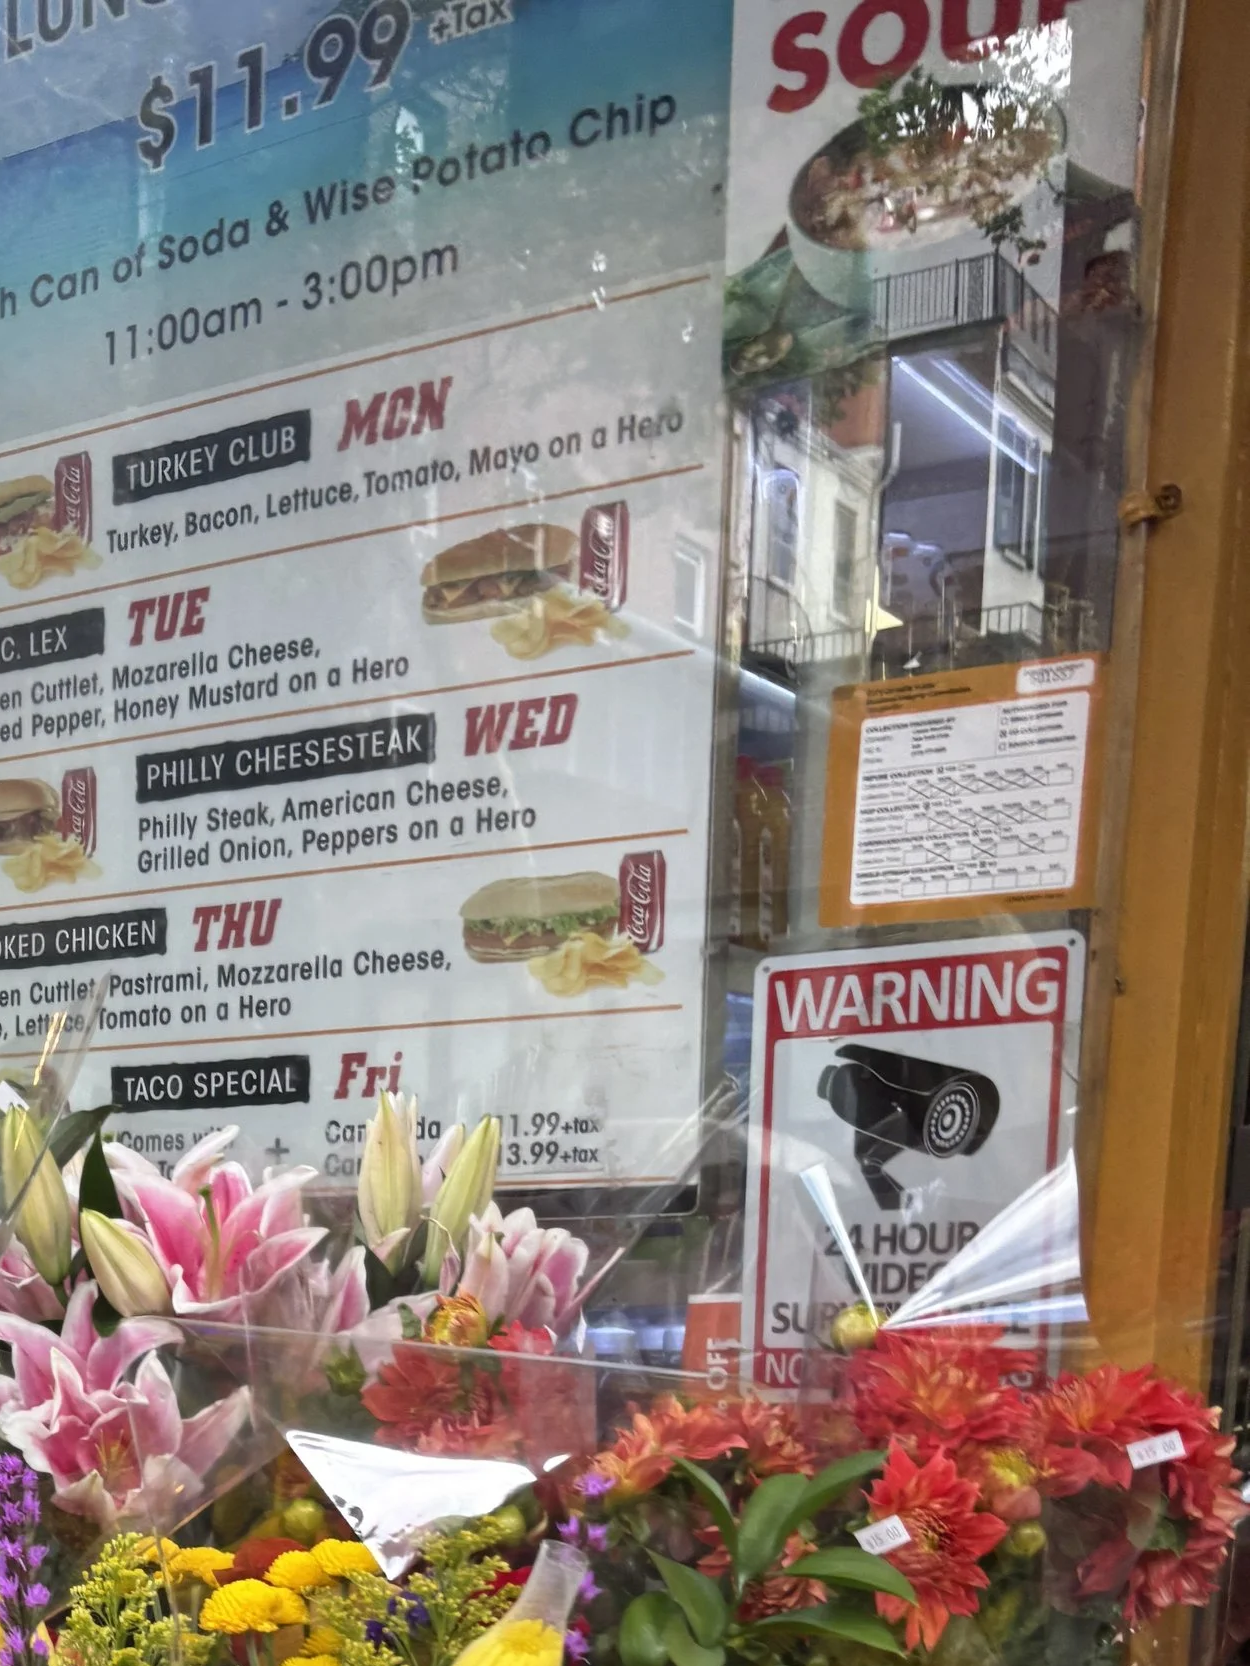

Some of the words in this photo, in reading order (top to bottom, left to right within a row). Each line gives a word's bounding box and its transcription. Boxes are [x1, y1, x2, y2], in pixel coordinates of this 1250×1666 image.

[137, 0, 413, 171] $11.99
[767, 0, 1082, 113] SOU
[30, 265, 99, 307] Can
[113, 248, 147, 284] of
[158, 218, 250, 270] Soda
[266, 200, 290, 237] &
[303, 176, 396, 225] Wise
[412, 129, 553, 195] Potato
[569, 93, 677, 149] Chip
[106, 297, 262, 366] 11:00am
[303, 243, 459, 311] 3:00pm
[107, 521, 179, 554] Turkey,
[185, 504, 259, 538] Bacon,
[266, 481, 359, 519] Lettuce,
[364, 458, 461, 498] Tomato,
[469, 441, 540, 477] Mayo
[549, 432, 582, 459] on
[591, 428, 607, 449] a
[618, 409, 683, 444] Hero
[126, 444, 219, 490] TURKEY
[229, 426, 296, 466] CLUB
[30, 626, 68, 657] LEX
[128, 586, 211, 647] TUE
[31, 674, 104, 707] Cuttlet,
[112, 652, 218, 690] Mozarella
[229, 636, 321, 670] Cheese,
[31, 705, 105, 739] Pepper,
[114, 692, 180, 725] Honey
[188, 672, 279, 710] Mustard
[288, 671, 318, 694] on
[327, 667, 341, 687] a
[352, 653, 410, 685] Hero
[146, 752, 225, 790] PHILLY
[235, 724, 423, 776] CHEESESTEAK
[464, 692, 579, 757] WED
[138, 811, 197, 842] Philly
[207, 798, 275, 833] Steak,
[282, 786, 396, 822] American
[406, 774, 509, 807] Cheese,
[138, 842, 210, 874] Grilled
[220, 833, 293, 864] Onion,
[302, 822, 398, 856] Peppers
[409, 818, 439, 841] on
[451, 815, 464, 836] a
[477, 806, 536, 833] Hero
[55, 919, 156, 954] CHICKEN
[192, 898, 282, 952] THU
[110, 966, 209, 999] Pastrami,
[217, 954, 343, 988] Mozzarella
[354, 947, 452, 977] Cheese,
[774, 957, 1061, 1033] WARNING
[181, 1003, 207, 1023] on
[216, 1001, 229, 1020] a
[239, 994, 292, 1020] Hero
[124, 1074, 183, 1102] TACO
[193, 1066, 296, 1098] SPECIAL
[333, 1050, 404, 1100] Fri
[120, 1130, 185, 1153] Comes
